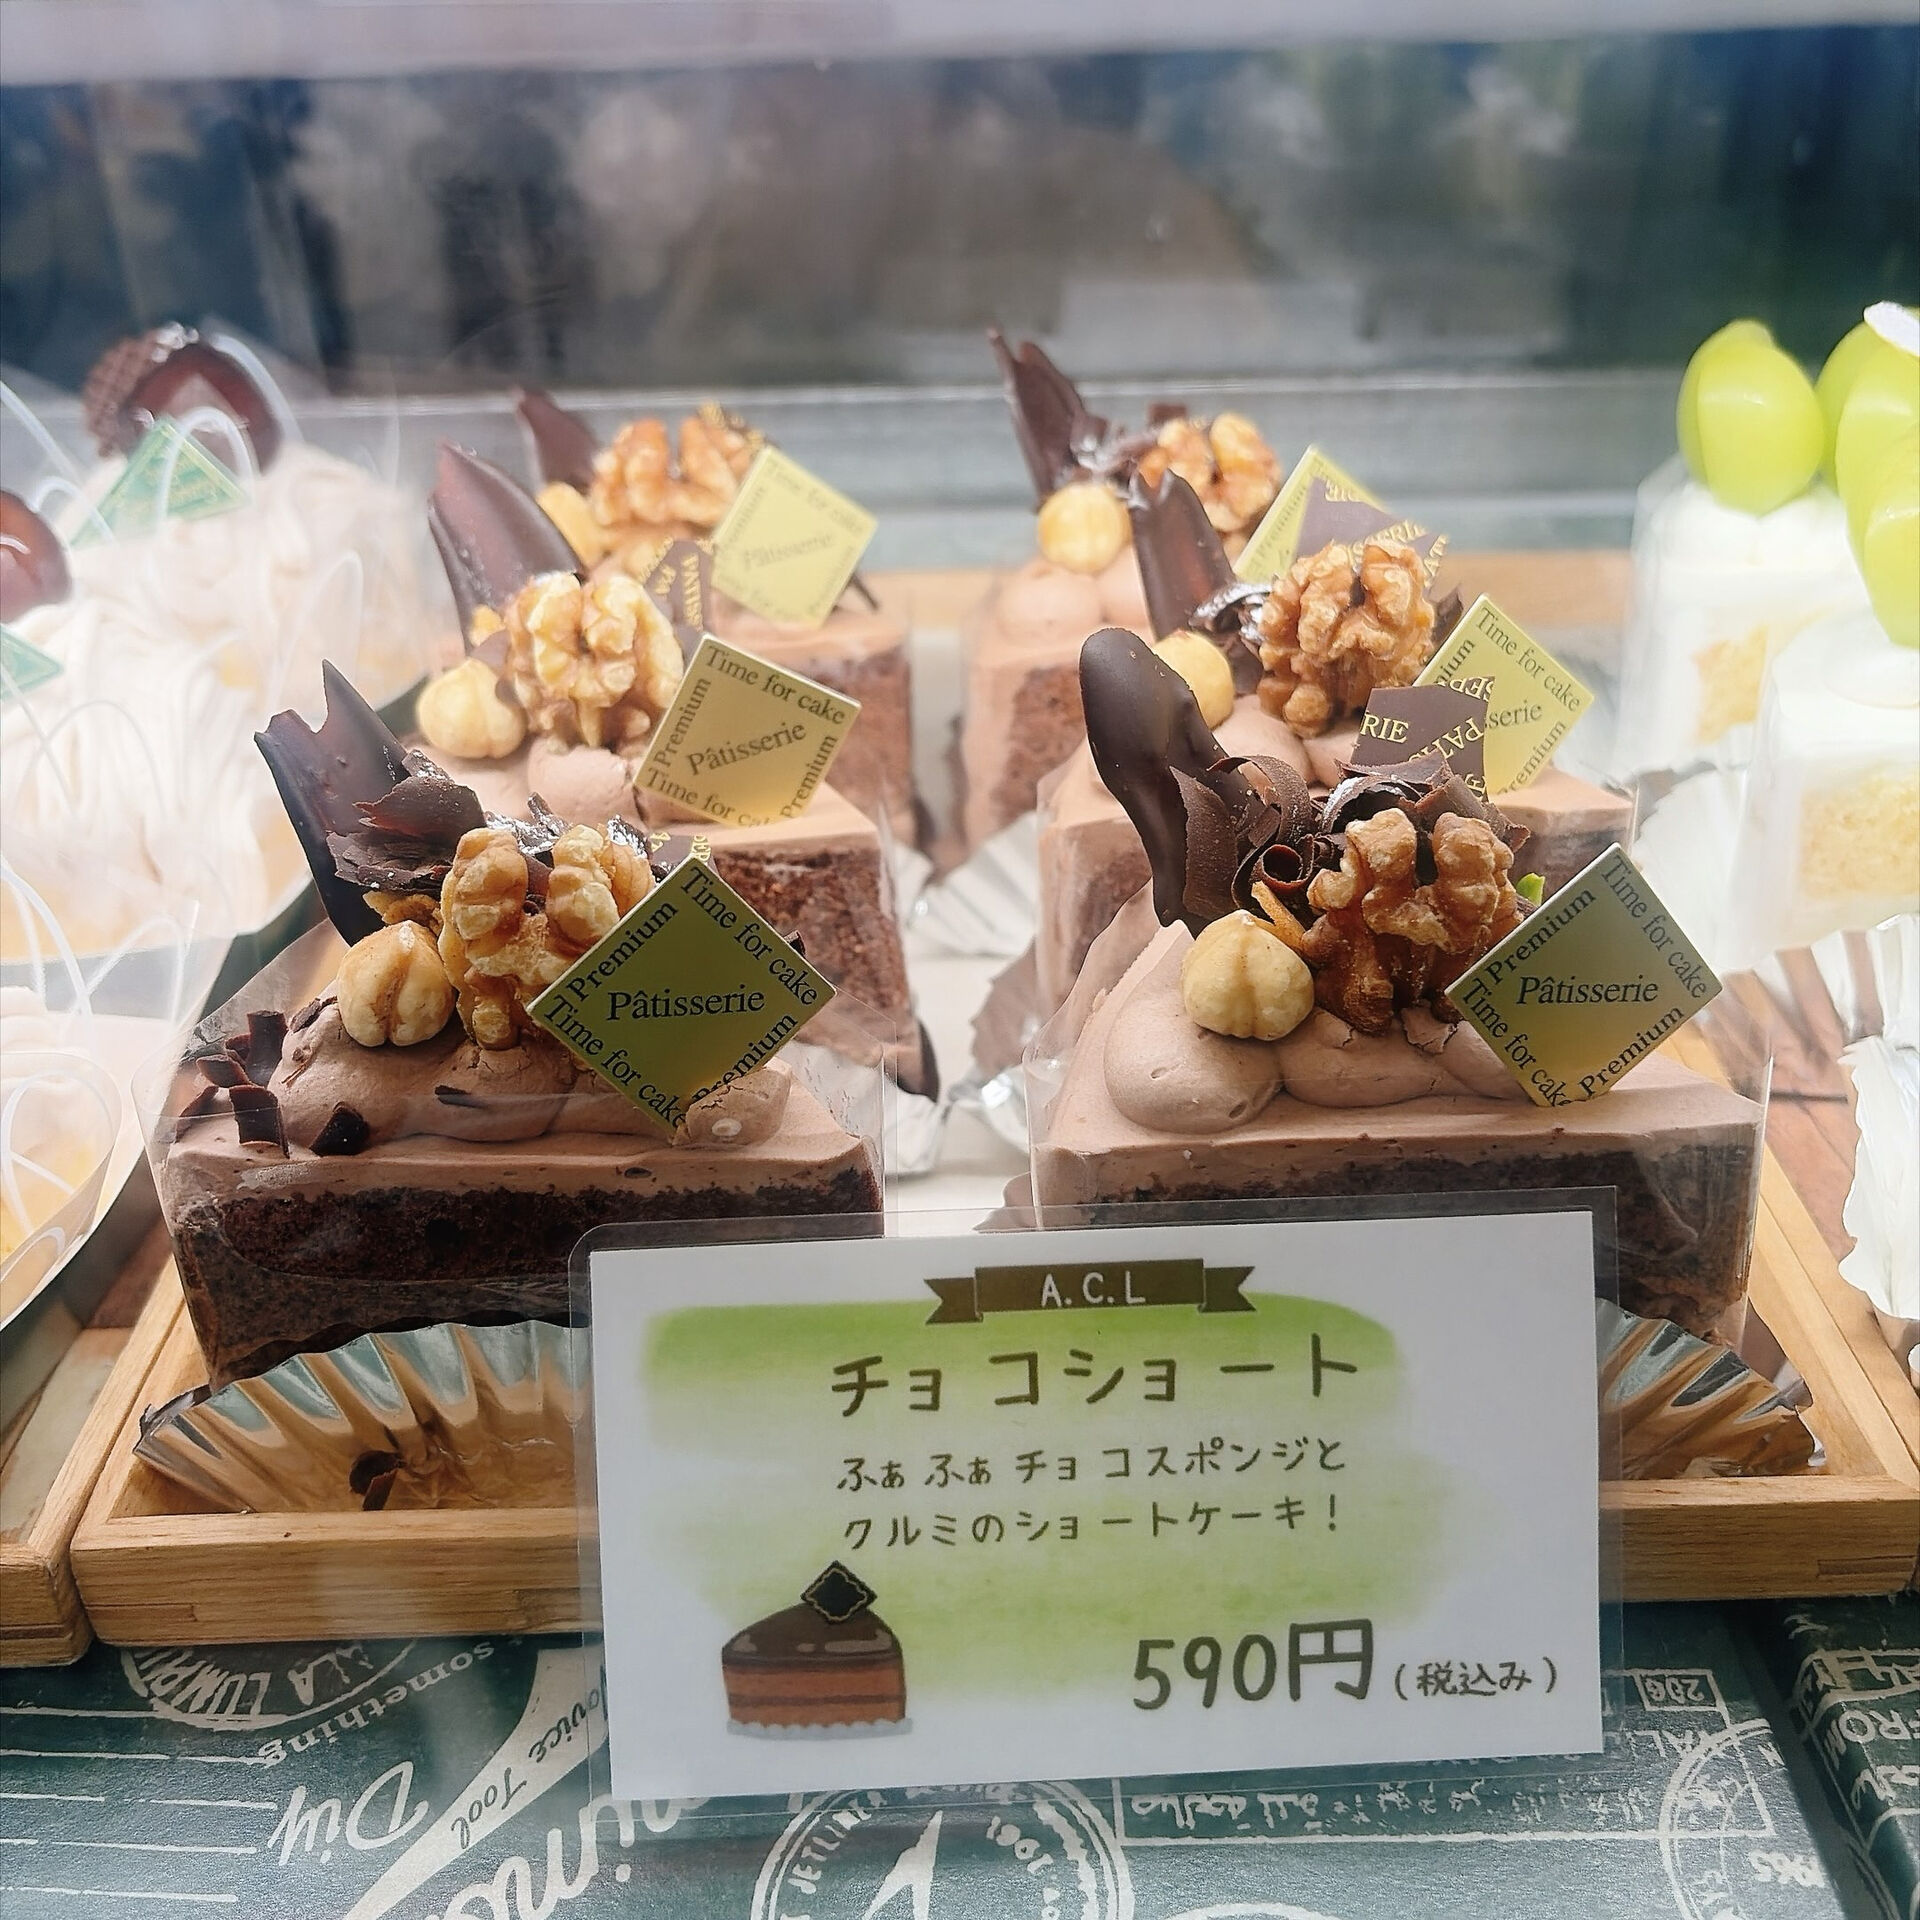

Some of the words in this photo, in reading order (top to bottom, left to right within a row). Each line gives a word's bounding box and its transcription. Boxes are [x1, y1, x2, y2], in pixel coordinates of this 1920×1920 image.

[705, 645, 759, 686] Time
[762, 673, 797, 702] for
[797, 692, 846, 725] cake
[1476, 607, 1518, 655] Time
[1516, 648, 1545, 679] for
[1544, 673, 1580, 712] cake
[653, 677, 712, 768] Premium
[687, 721, 807, 777] Pâtisserie
[1496, 719, 1567, 795] remium
[647, 766, 699, 806] Time
[701, 794, 736, 819] for
[779, 735, 838, 819] Premium
[566, 901, 679, 1002] Premium
[680, 866, 738, 929] Time
[734, 923, 773, 961] for
[768, 957, 819, 1006] cake
[1484, 888, 1597, 986] Premium
[1601, 855, 1648, 918] Time
[1642, 914, 1674, 952] for
[1668, 950, 1707, 999] cake
[606, 984, 766, 1021] Pâtisserie
[1462, 977, 1509, 1038] Time
[1504, 1033, 1537, 1071] for
[1516, 974, 1659, 1006] Pâtisserie
[543, 995, 604, 1056] Time
[601, 1049, 642, 1087] for
[638, 1083, 688, 1127] cake
[1578, 1006, 1685, 1098] Premium
[1041, 1271, 1146, 1307] A.C.L
[831, 1332, 1358, 1417] チョコショート
[258, 1641, 495, 1768] something
[1133, 1618, 1374, 1711] 590円
[1394, 1656, 1558, 1702] (税込み)
[529, 1668, 607, 1763] ovice
[268, 1761, 428, 1867] Diy
[451, 1766, 527, 1849] Tool
